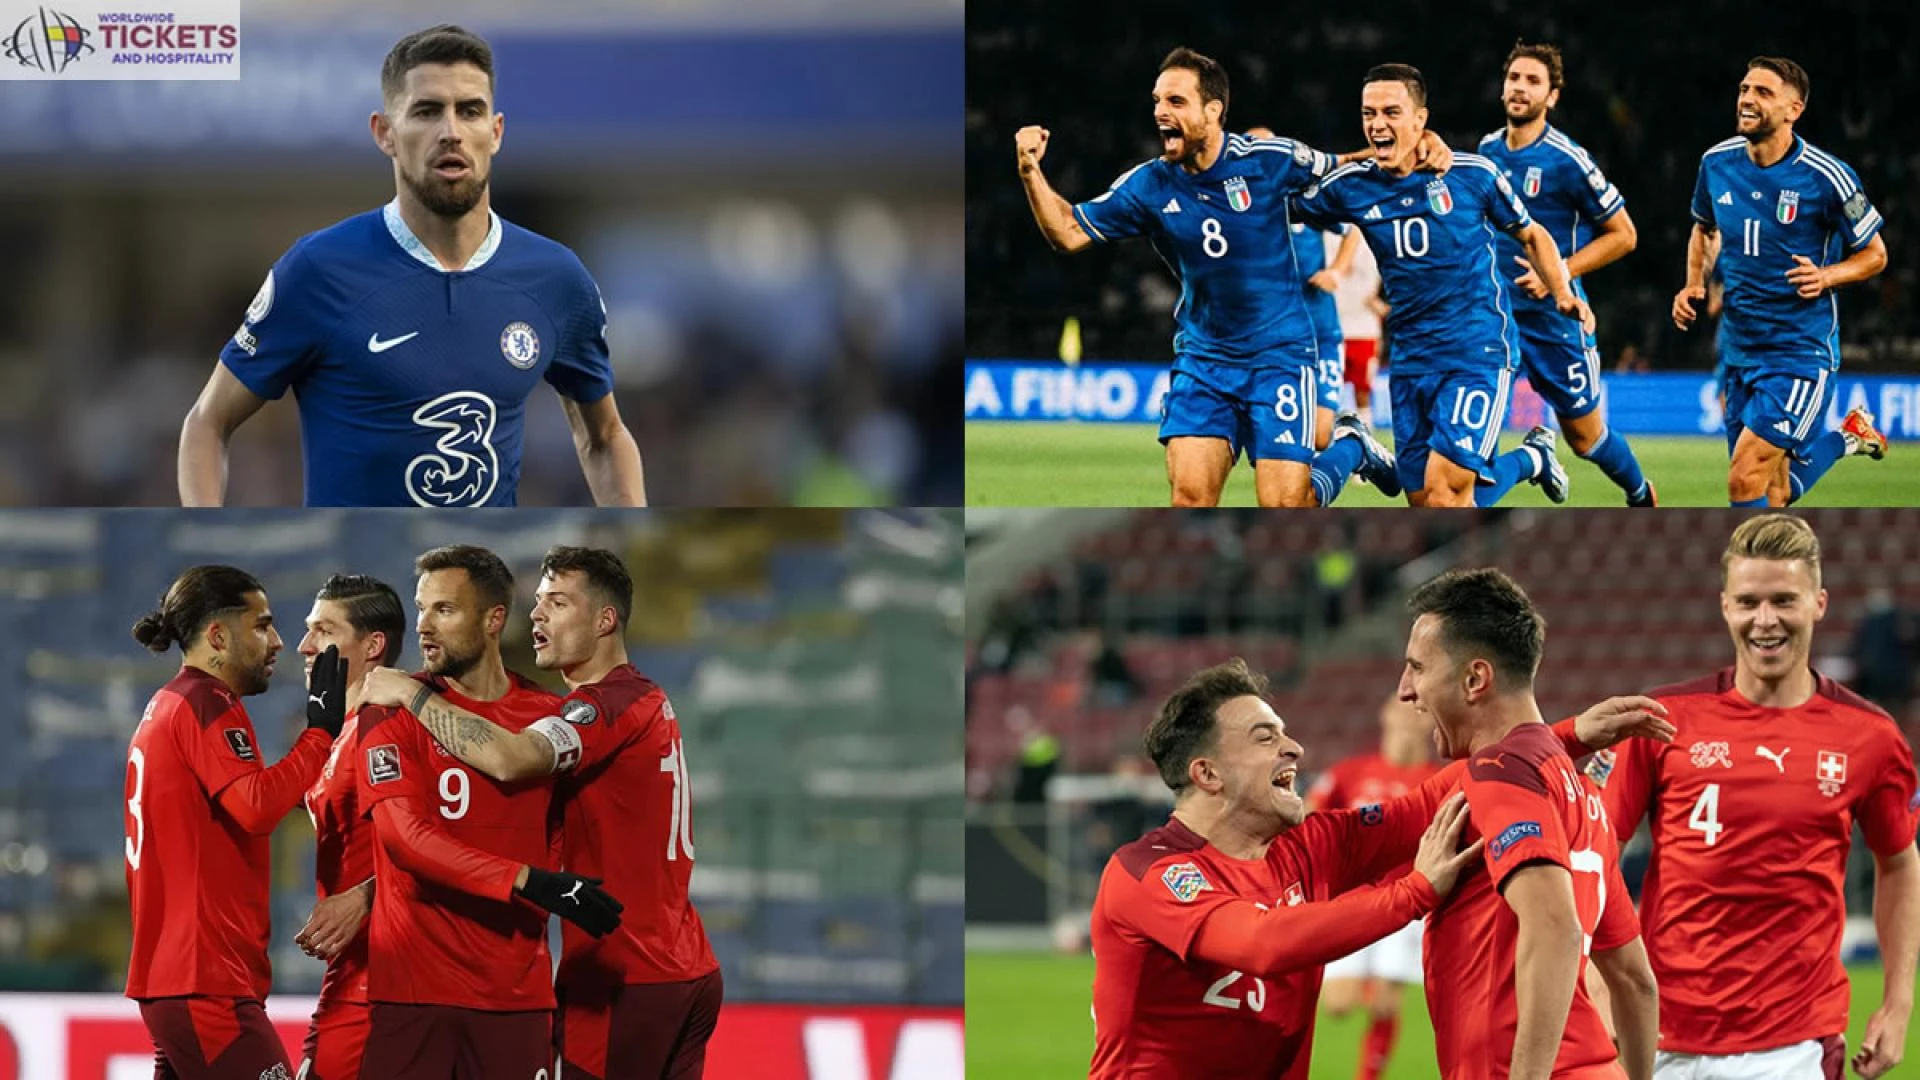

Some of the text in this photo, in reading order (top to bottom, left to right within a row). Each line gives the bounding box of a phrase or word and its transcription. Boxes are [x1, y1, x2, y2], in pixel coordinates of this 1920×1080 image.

[1201, 218, 1228, 258] 8
[1393, 217, 1429, 258] 10
[1743, 218, 1761, 257] 11
[1567, 362, 1588, 393] 5
[1785, 378, 1811, 416] 11
[1274, 383, 1299, 422] 8
[1451, 386, 1490, 430] 10
[439, 767, 470, 820] 9
[1688, 783, 1723, 846] 4
[1500, 823, 1541, 847] RESPECT
